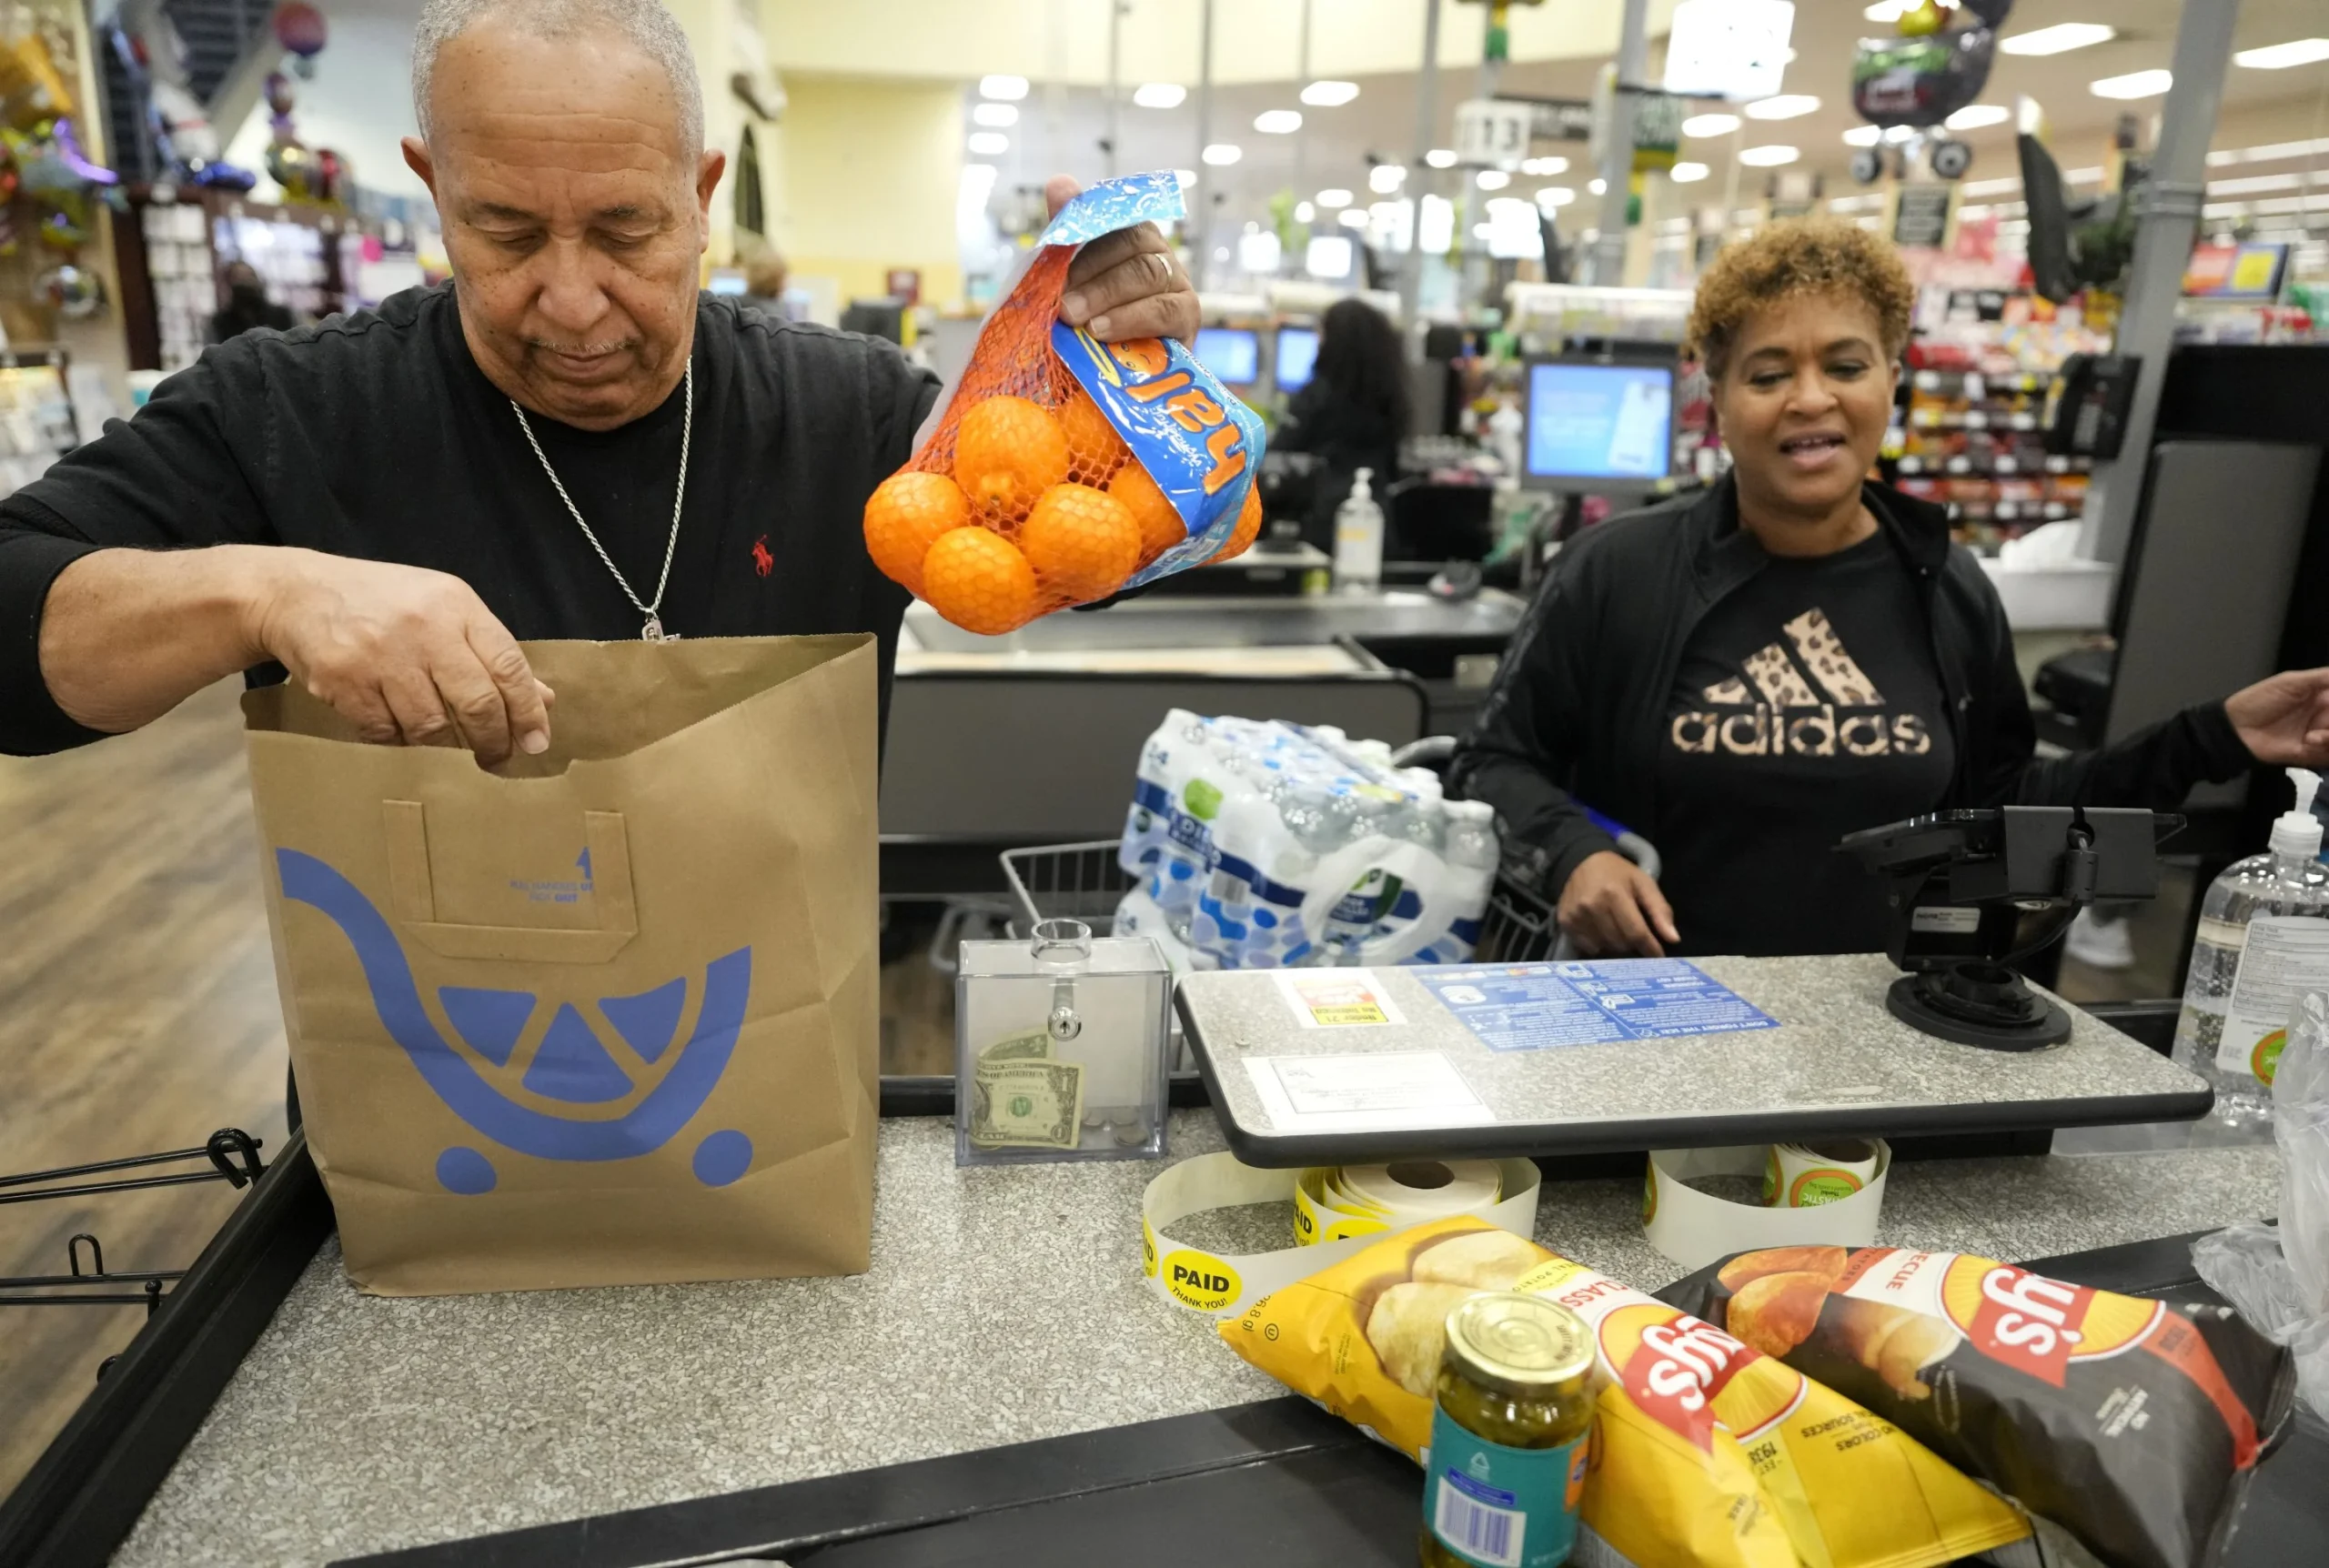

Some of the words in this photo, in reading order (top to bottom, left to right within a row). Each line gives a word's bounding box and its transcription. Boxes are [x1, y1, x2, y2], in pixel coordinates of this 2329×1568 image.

[1672, 703, 1931, 757] adidas
[1803, 1193, 1838, 1205] TASTIC
[1173, 1264, 1230, 1293] PAID
[1511, 1267, 1555, 1292] POTATO
[1172, 1286, 1202, 1309] THANK
[1205, 1298, 1228, 1310] YOU!
[1558, 1281, 1630, 1309] CLASS
[1981, 1267, 2083, 1357] y's
[1801, 1414, 1854, 1439] SOURCES
[1747, 1440, 1778, 1465] 1938
[1836, 1428, 1881, 1452] COLORS
